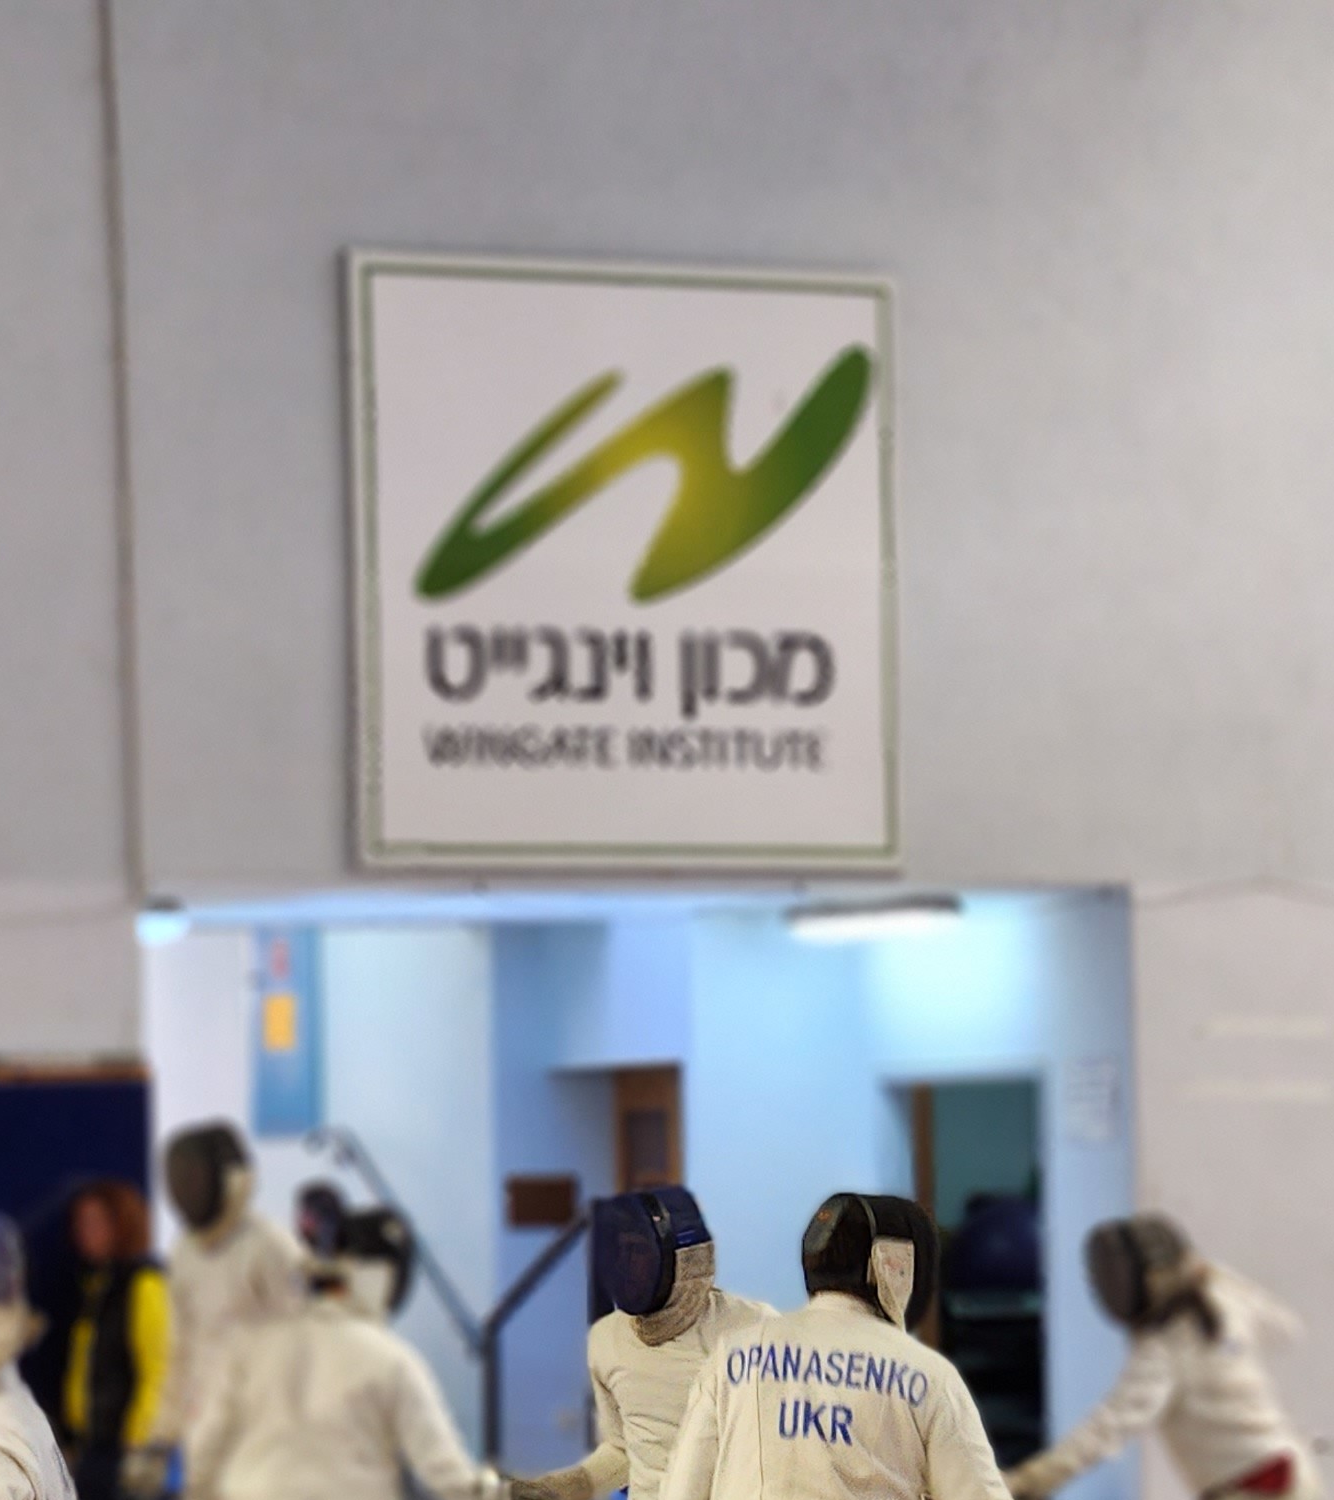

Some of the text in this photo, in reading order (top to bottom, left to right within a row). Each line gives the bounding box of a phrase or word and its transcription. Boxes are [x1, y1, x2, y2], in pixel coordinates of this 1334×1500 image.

[424, 623, 835, 718] מכון וינגייט
[421, 722, 826, 771] WINGATE INSTITUTE
[726, 1343, 928, 1407] OPANASENKO
[778, 1400, 853, 1446] UKR
